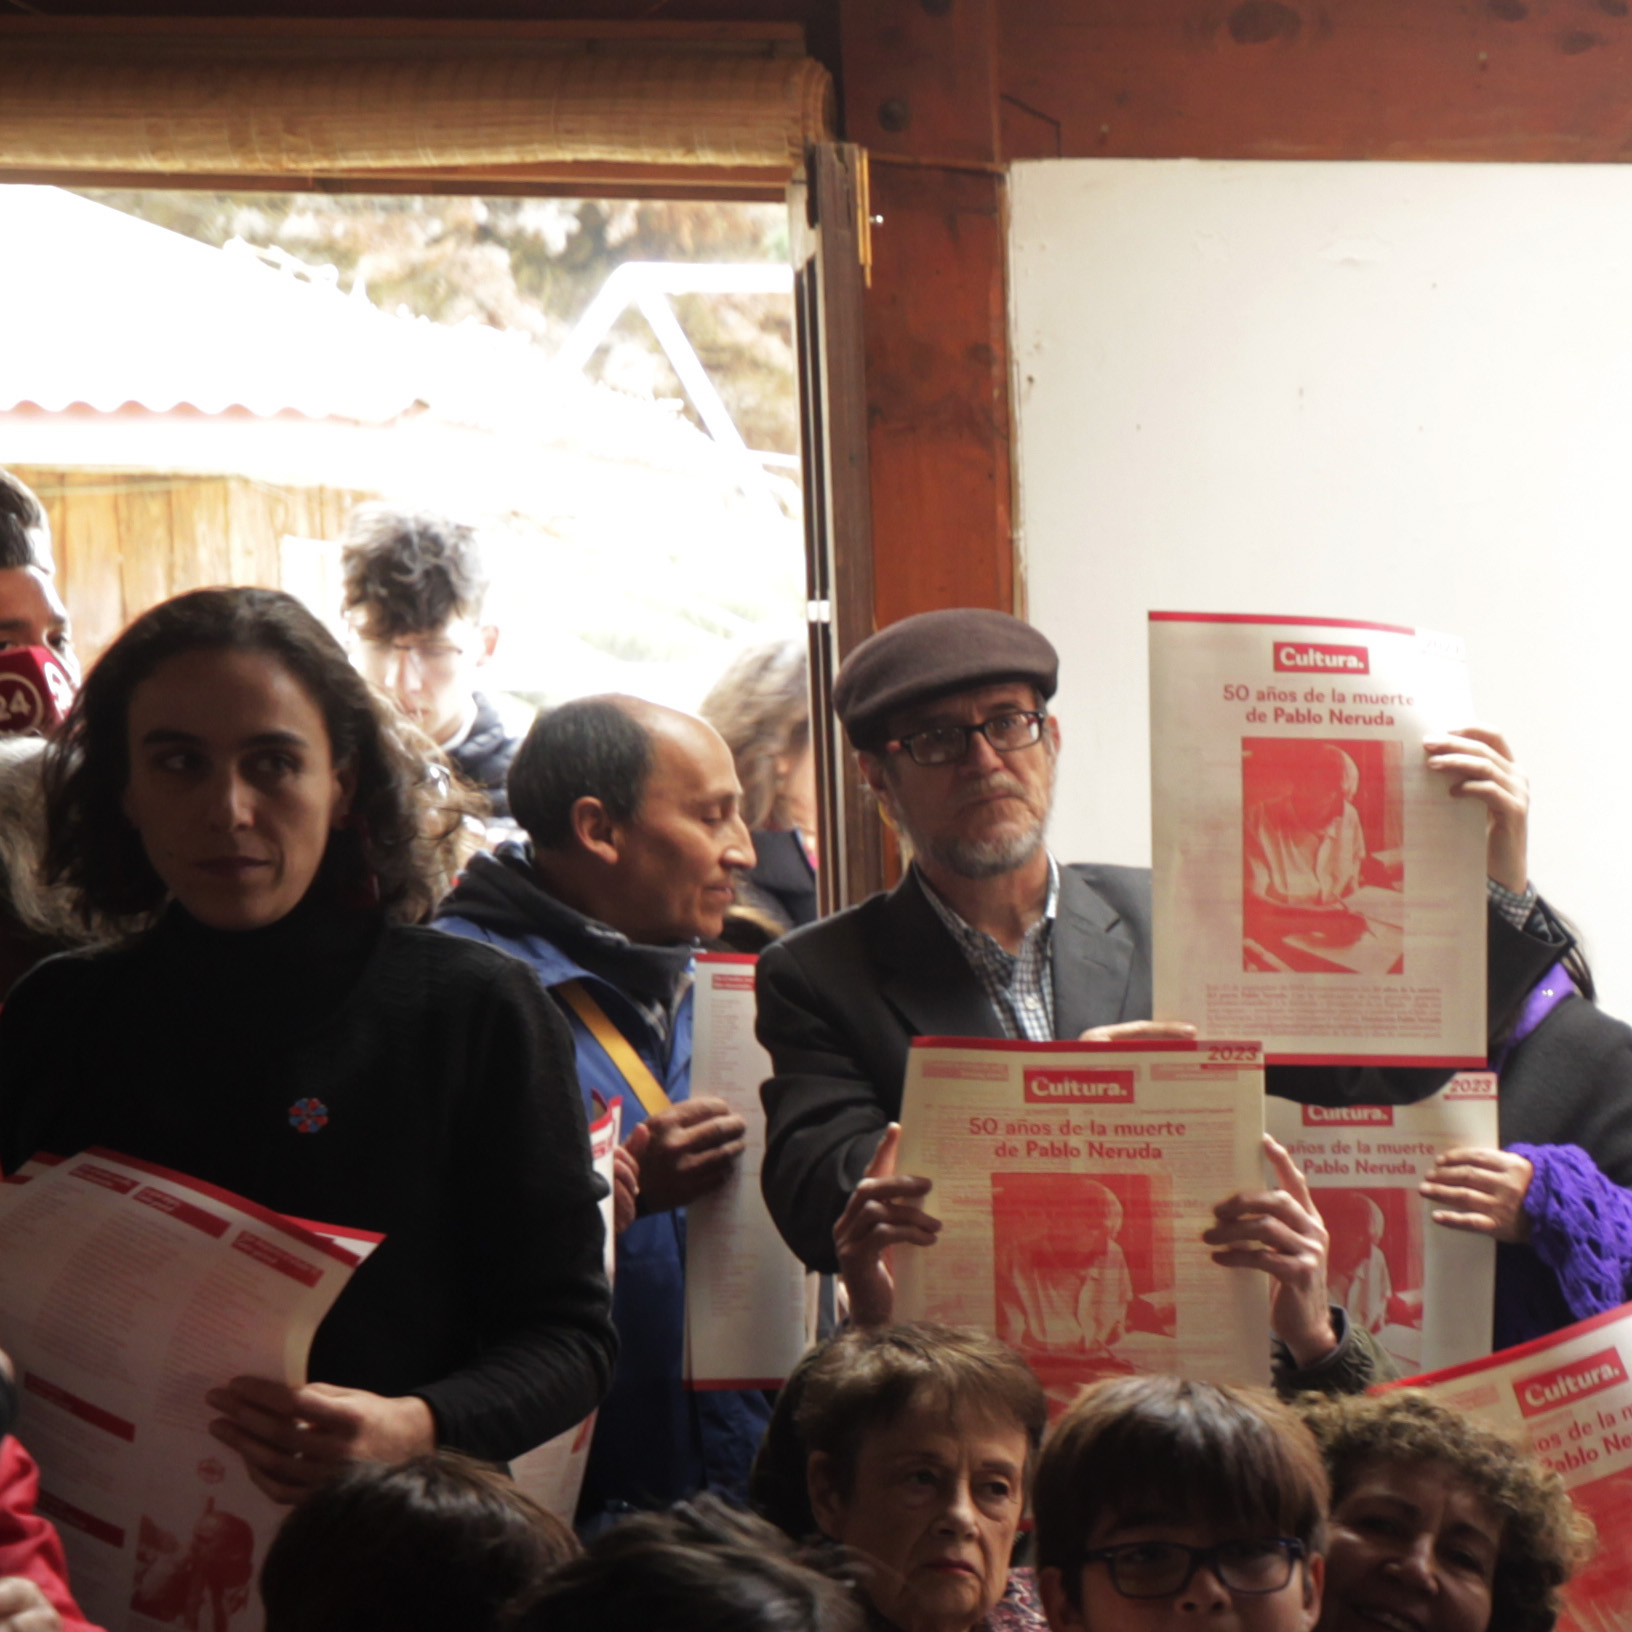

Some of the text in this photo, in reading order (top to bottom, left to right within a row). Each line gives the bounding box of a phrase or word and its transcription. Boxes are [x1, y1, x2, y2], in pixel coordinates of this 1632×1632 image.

[1279, 646, 1365, 669] Cultura.
[1223, 684, 1414, 706] 50 años de la muerte
[1245, 707, 1395, 726] de Pablo Neruda
[1207, 1045, 1258, 1062] 2023
[1030, 1076, 1128, 1097] Cultura.
[1450, 1078, 1493, 1093] 2023
[1307, 1104, 1389, 1121] Cultura.
[968, 1117, 1187, 1137] 50 años de la muerte
[994, 1140, 1163, 1160] de Pablo Neruda
[1331, 1139, 1350, 1155] de
[1357, 1139, 1371, 1155] la
[1376, 1142, 1435, 1155] muerte
[1303, 1158, 1417, 1175] Pablo Neruda
[1524, 1363, 1621, 1408] Cultura.
[1535, 1432, 1562, 1453] os
[1567, 1420, 1594, 1442] de
[1596, 1410, 1617, 1430] la
